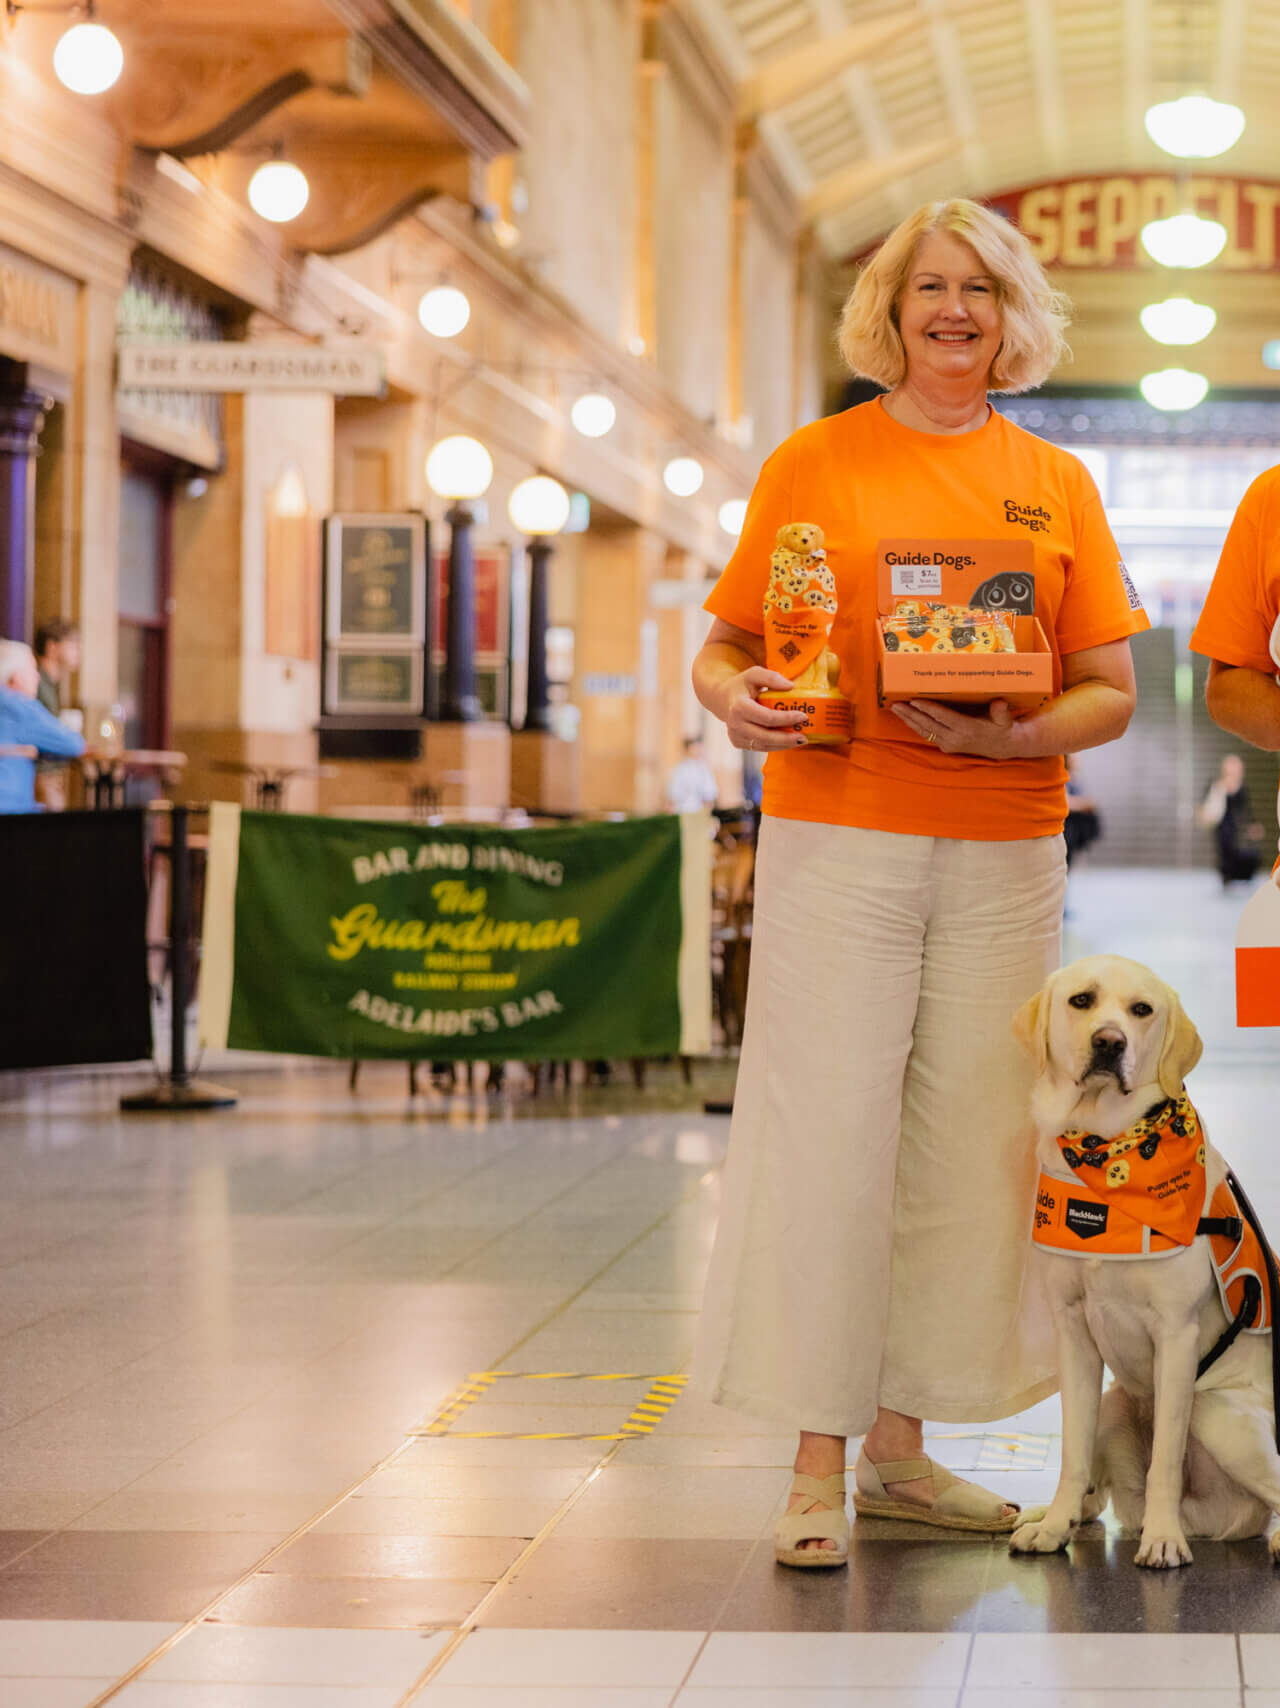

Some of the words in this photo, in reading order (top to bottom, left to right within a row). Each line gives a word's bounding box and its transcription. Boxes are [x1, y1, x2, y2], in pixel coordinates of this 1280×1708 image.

[1003, 499, 1052, 521] Guide
[1005, 511, 1051, 533] Dogs.
[885, 552, 930, 566] Guide
[933, 552, 976, 570] Dogs.
[774, 701, 816, 714] Guide
[352, 847, 411, 885] BAR
[414, 842, 470, 871] AND
[472, 844, 565, 887] DINING
[431, 880, 488, 914] The
[328, 903, 581, 960] Guardsman
[347, 988, 499, 1037] ADELAIDE'S
[501, 989, 564, 1028] BAR
[1146, 1179, 1168, 1193] Puppy
[1158, 1188, 1176, 1199] Guide
[1037, 1189, 1055, 1209] ide
